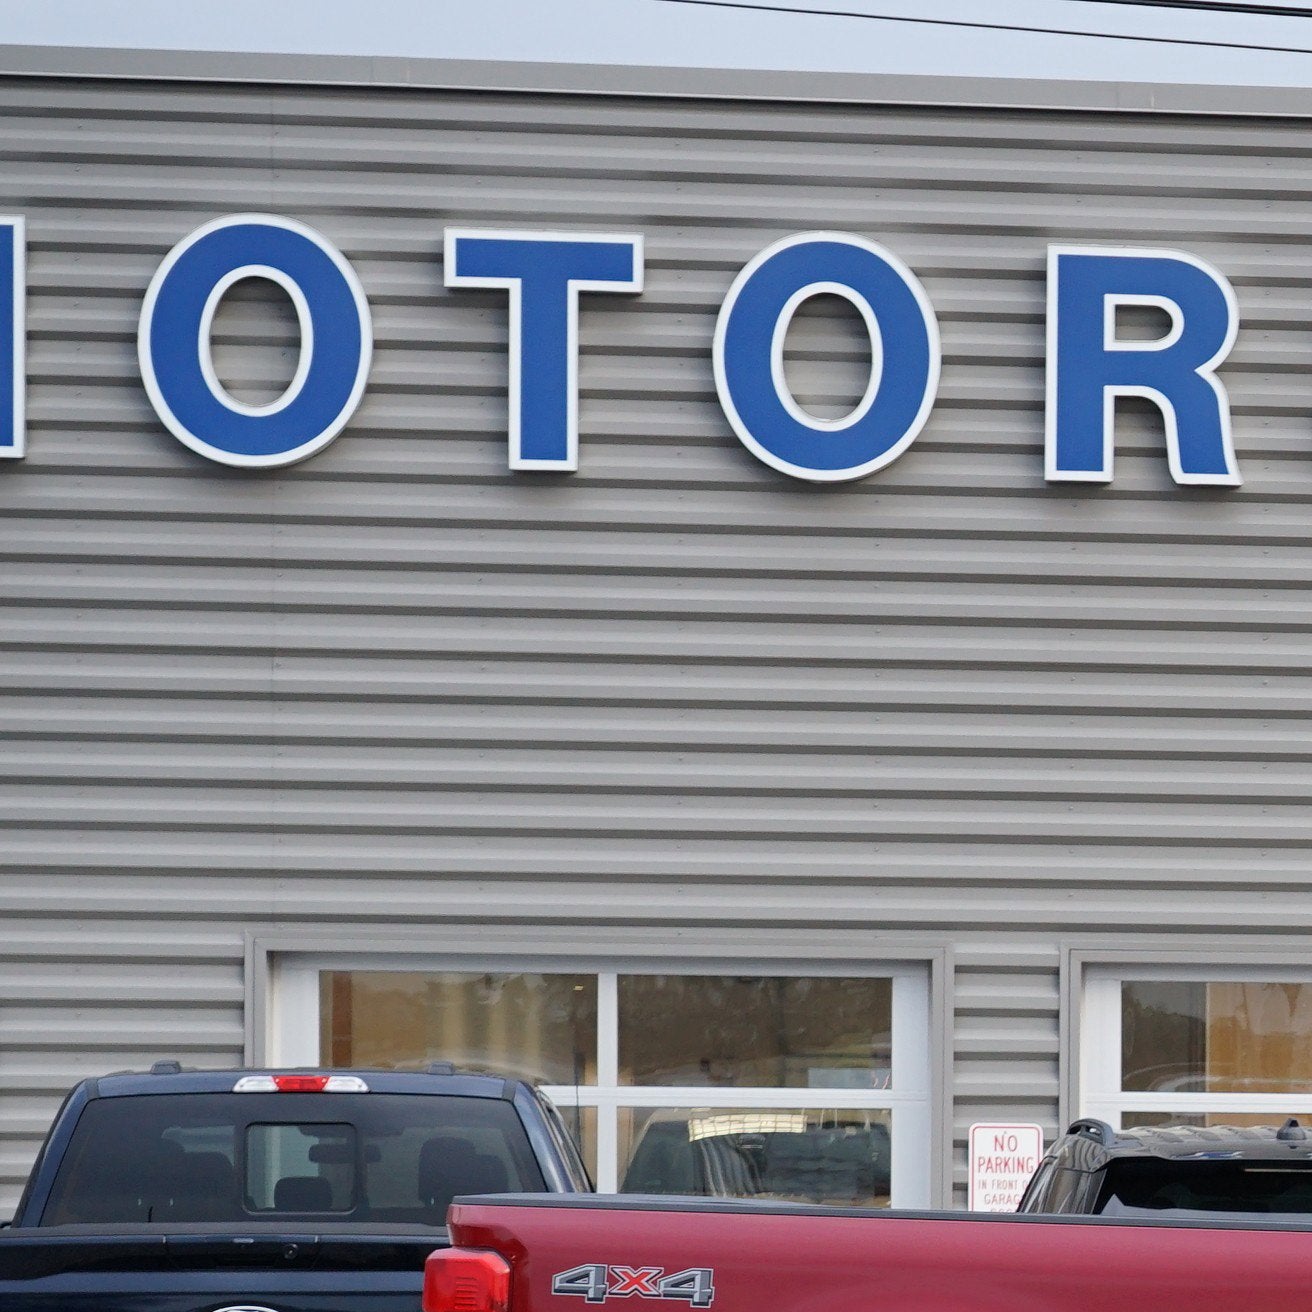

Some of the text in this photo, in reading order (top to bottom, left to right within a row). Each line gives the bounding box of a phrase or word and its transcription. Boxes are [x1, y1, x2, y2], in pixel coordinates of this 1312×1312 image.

[994, 1135, 1018, 1152] NO
[978, 1156, 1034, 1174] PARKING
[992, 1180, 1018, 1189] FRONT
[984, 1194, 1020, 1204] GARAG
